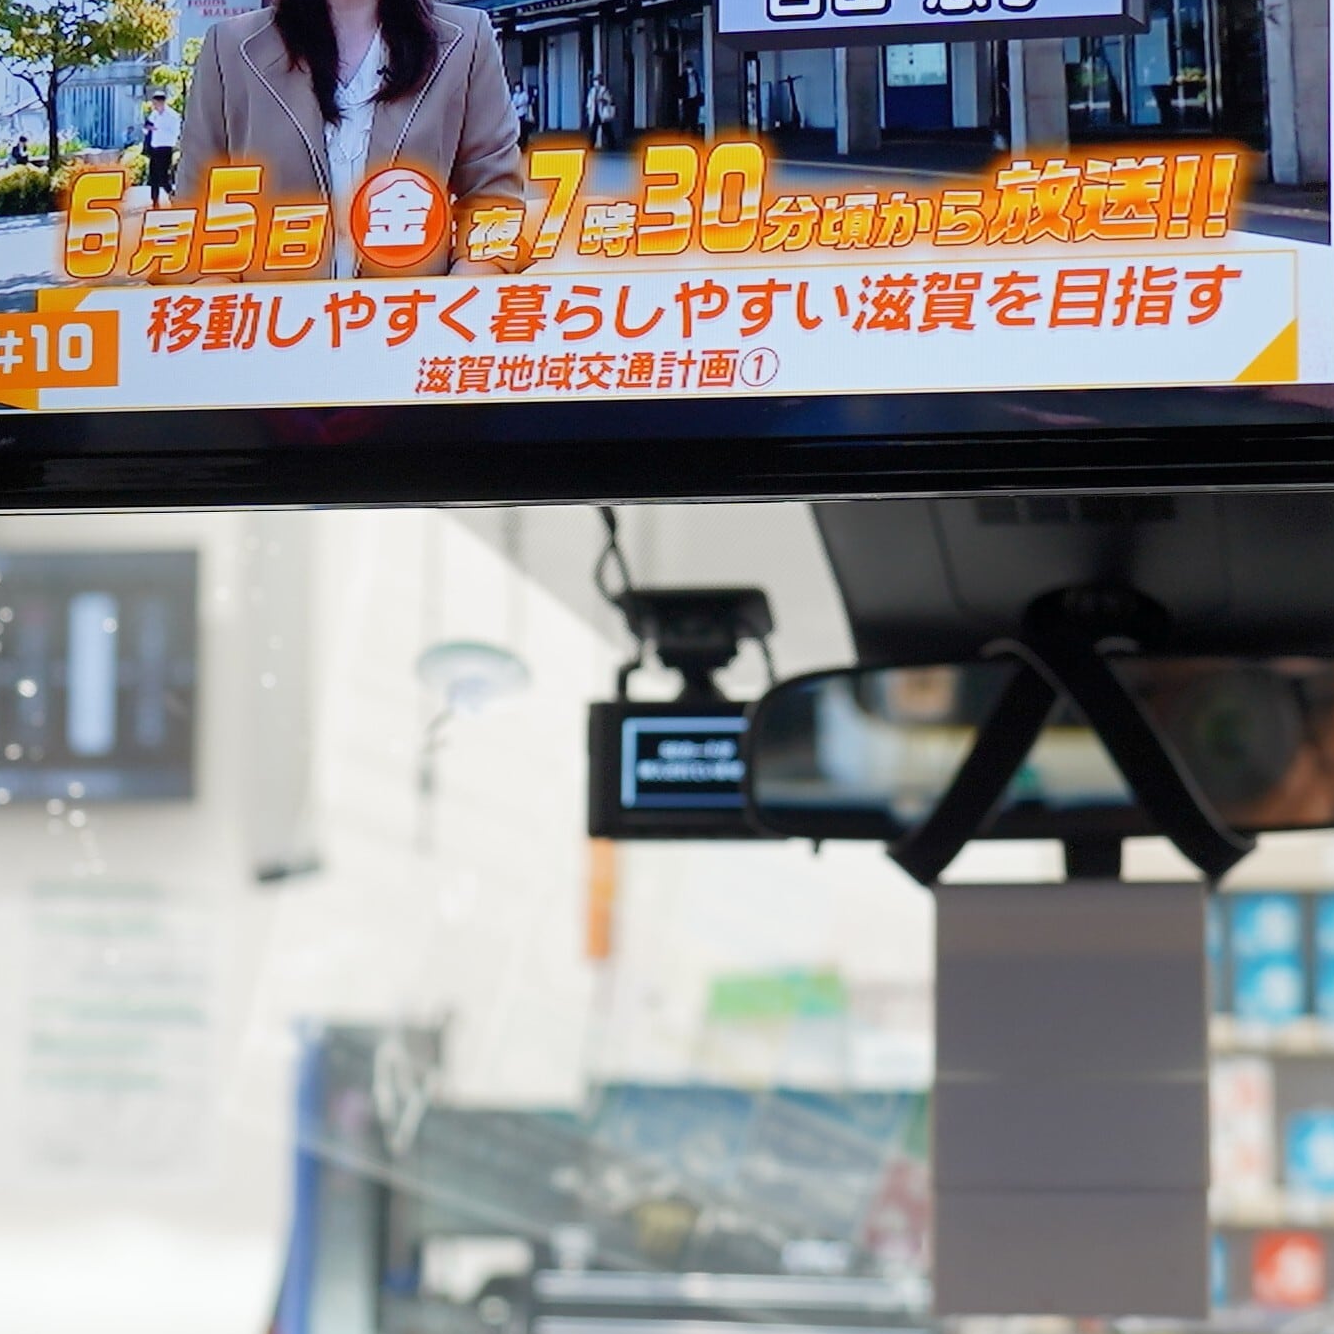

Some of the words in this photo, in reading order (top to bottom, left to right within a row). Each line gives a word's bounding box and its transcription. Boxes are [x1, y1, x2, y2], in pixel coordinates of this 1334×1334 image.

[66, 166, 329, 279] 6月5日
[359, 175, 438, 251] 金
[147, 264, 1243, 354] 移動しやすく暮らしやすい滋賀を目指す
